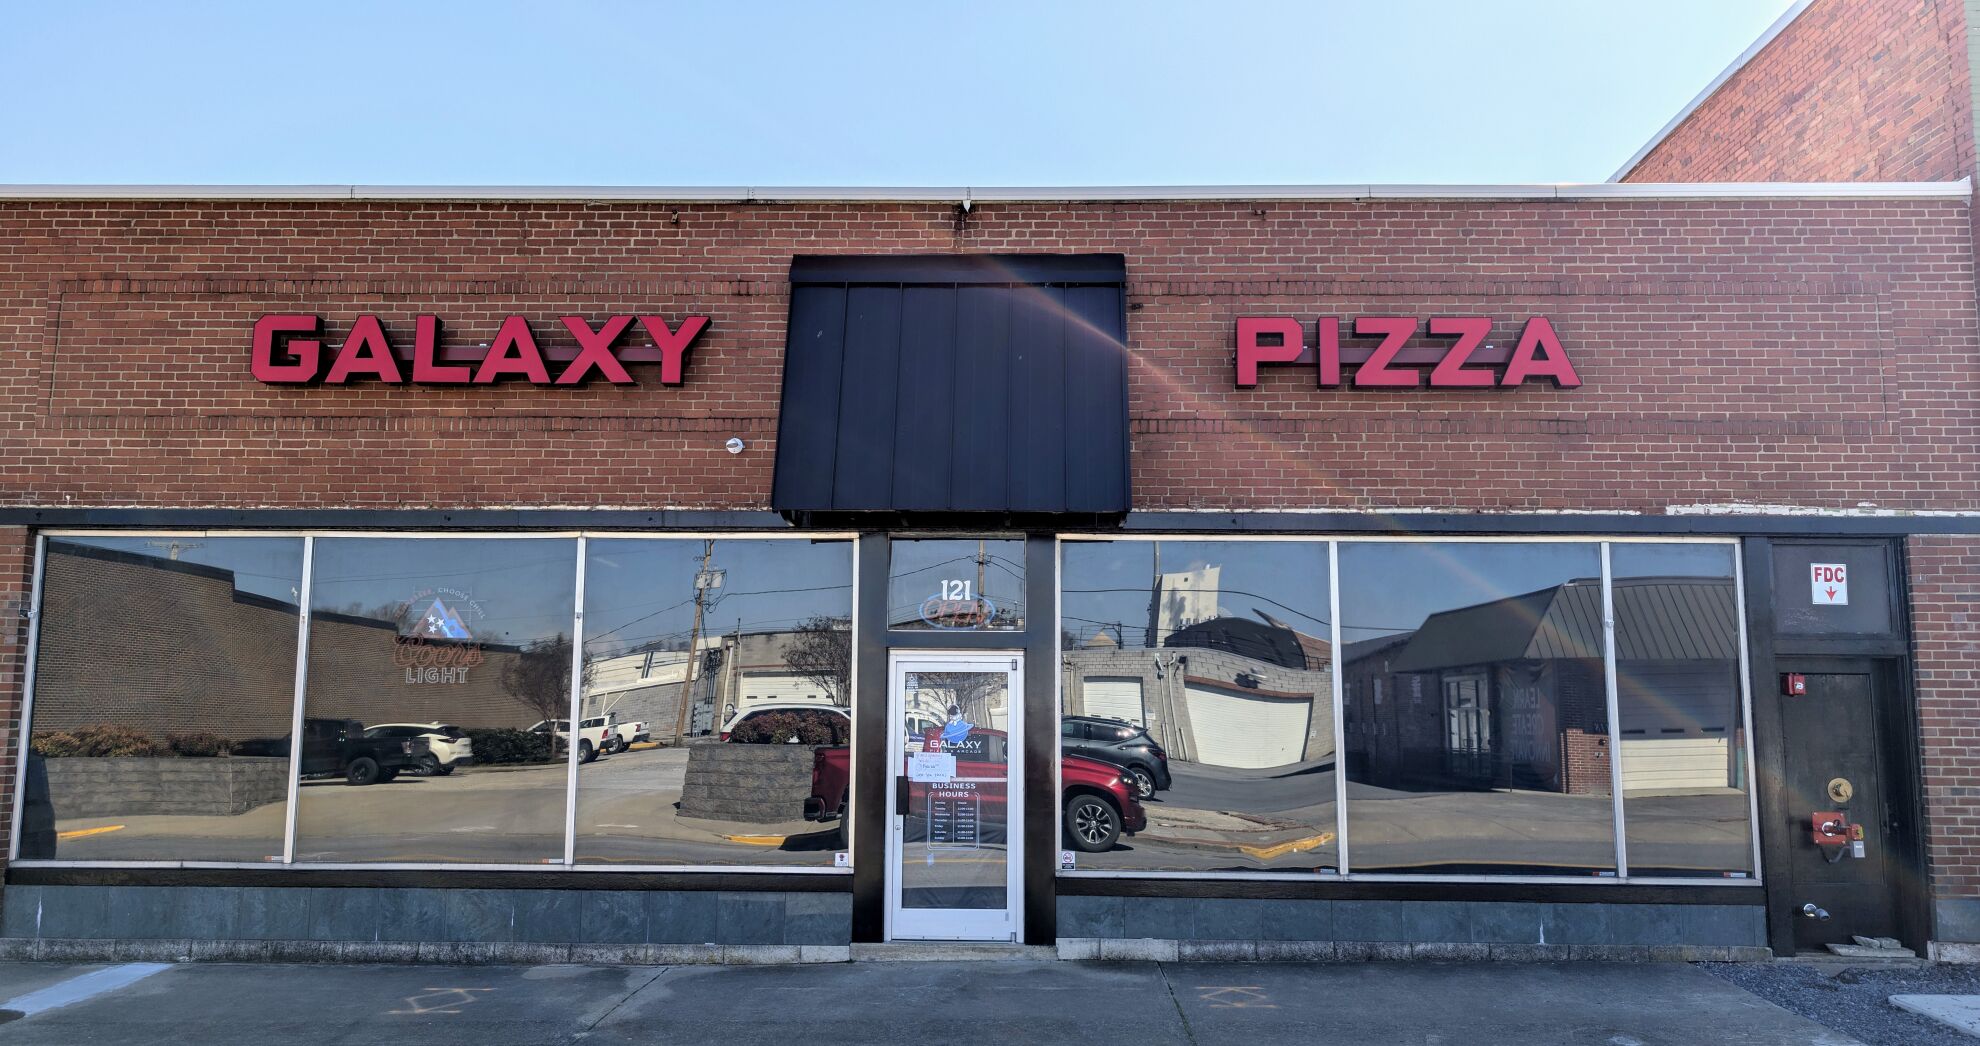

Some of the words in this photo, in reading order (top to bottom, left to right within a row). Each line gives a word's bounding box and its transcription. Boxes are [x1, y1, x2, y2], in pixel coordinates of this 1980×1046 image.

[250, 314, 710, 386] GALAXY
[1235, 316, 1582, 388] PIZZA
[1814, 566, 1845, 583] FDC
[941, 579, 971, 601] 121
[438, 587, 469, 601] CHOOSE
[469, 600, 486, 619] CHILL
[924, 600, 989, 624] OPEN
[393, 634, 485, 667] Coors
[405, 667, 469, 684] LIGHT
[930, 739, 982, 749] GALAXY
[932, 782, 976, 790] BUSINESS
